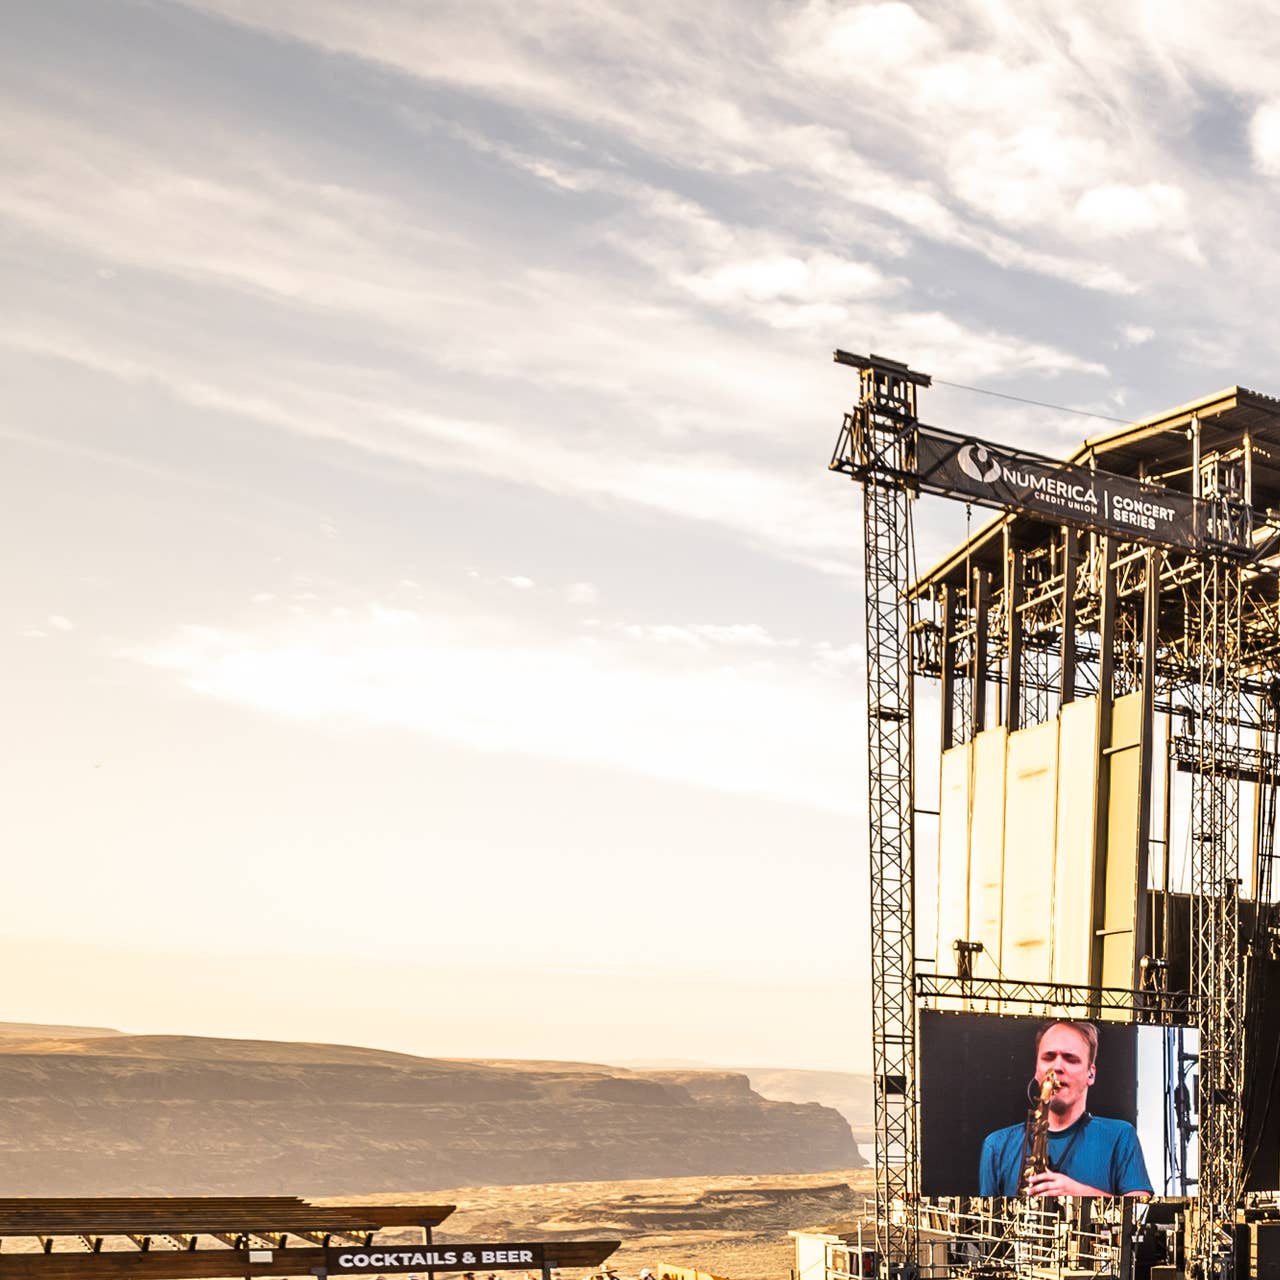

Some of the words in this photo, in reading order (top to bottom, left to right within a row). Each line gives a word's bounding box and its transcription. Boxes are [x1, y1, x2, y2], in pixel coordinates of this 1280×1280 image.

[1002, 466, 1098, 505] NUMERICA
[1034, 491, 1066, 506] CREDIT
[1068, 500, 1098, 515] UNION
[1113, 495, 1176, 522] CONCERT
[1113, 508, 1156, 530] SERIES
[338, 1251, 458, 1268] COCKTAILS
[462, 1251, 476, 1264] &
[481, 1250, 533, 1264] BEER
